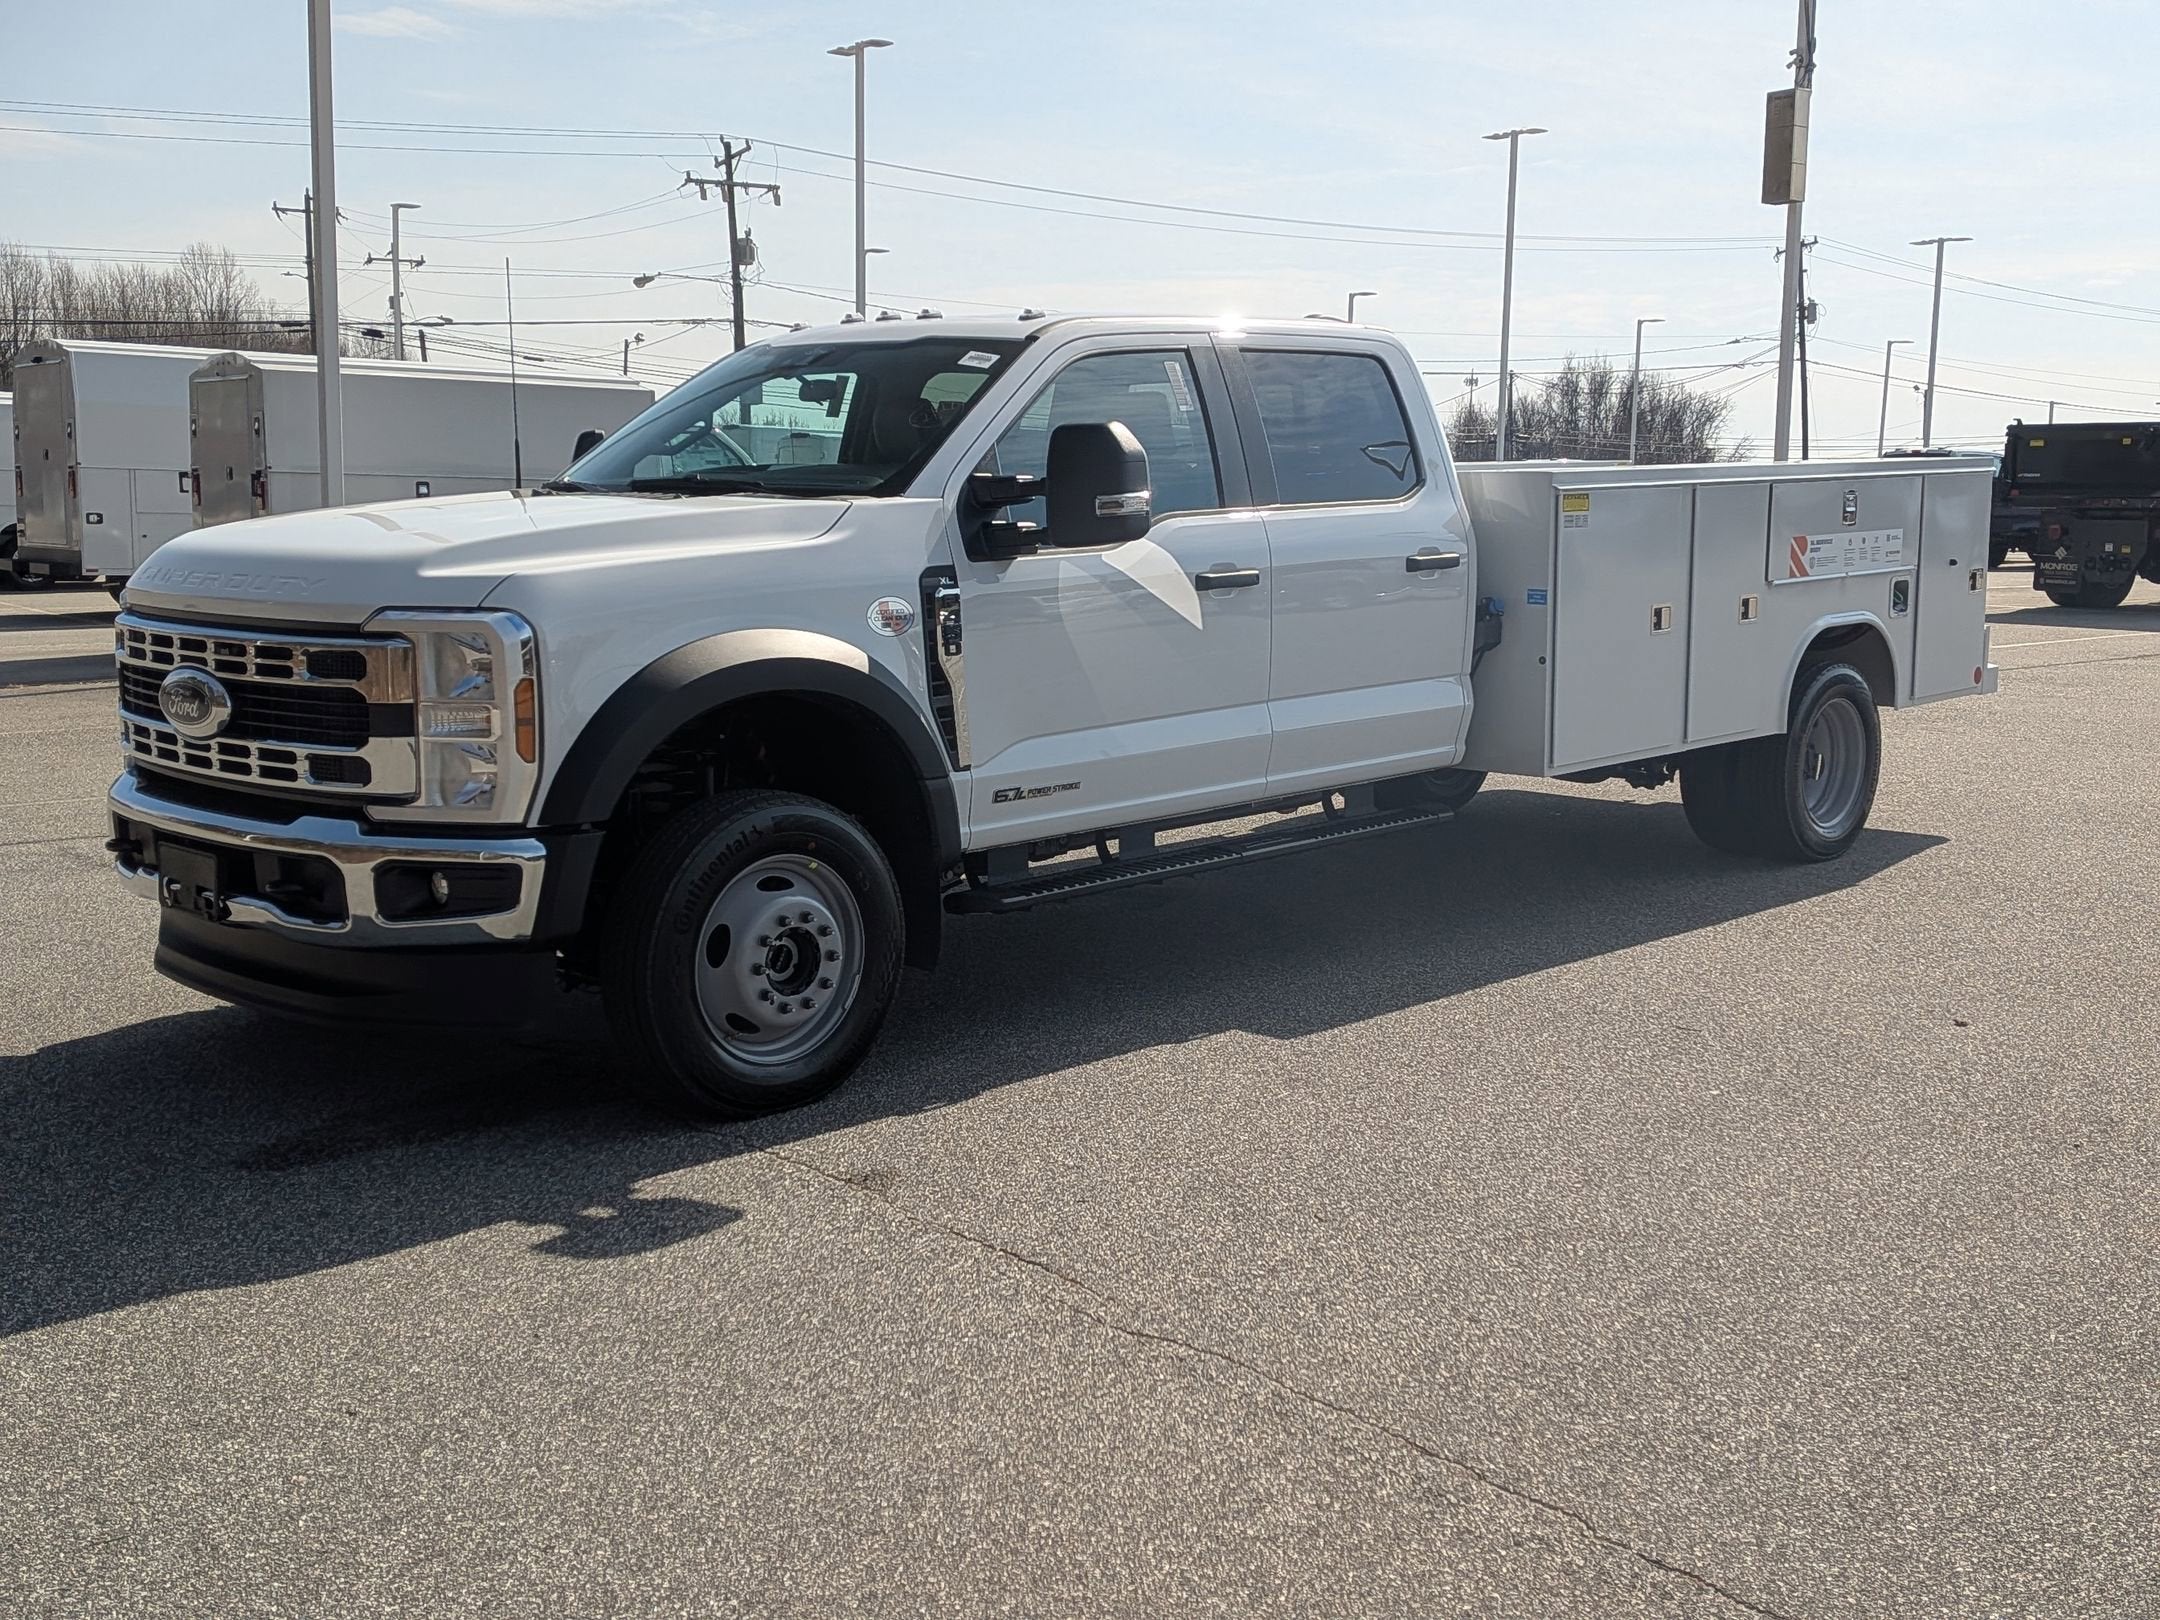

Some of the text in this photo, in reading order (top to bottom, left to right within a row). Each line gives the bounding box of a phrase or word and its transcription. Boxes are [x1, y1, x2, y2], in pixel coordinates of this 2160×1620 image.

[939, 577, 955, 585] XL
[168, 693, 199, 718] Ford
[1027, 786, 1052, 796] POWER
[673, 829, 752, 936] Continental
